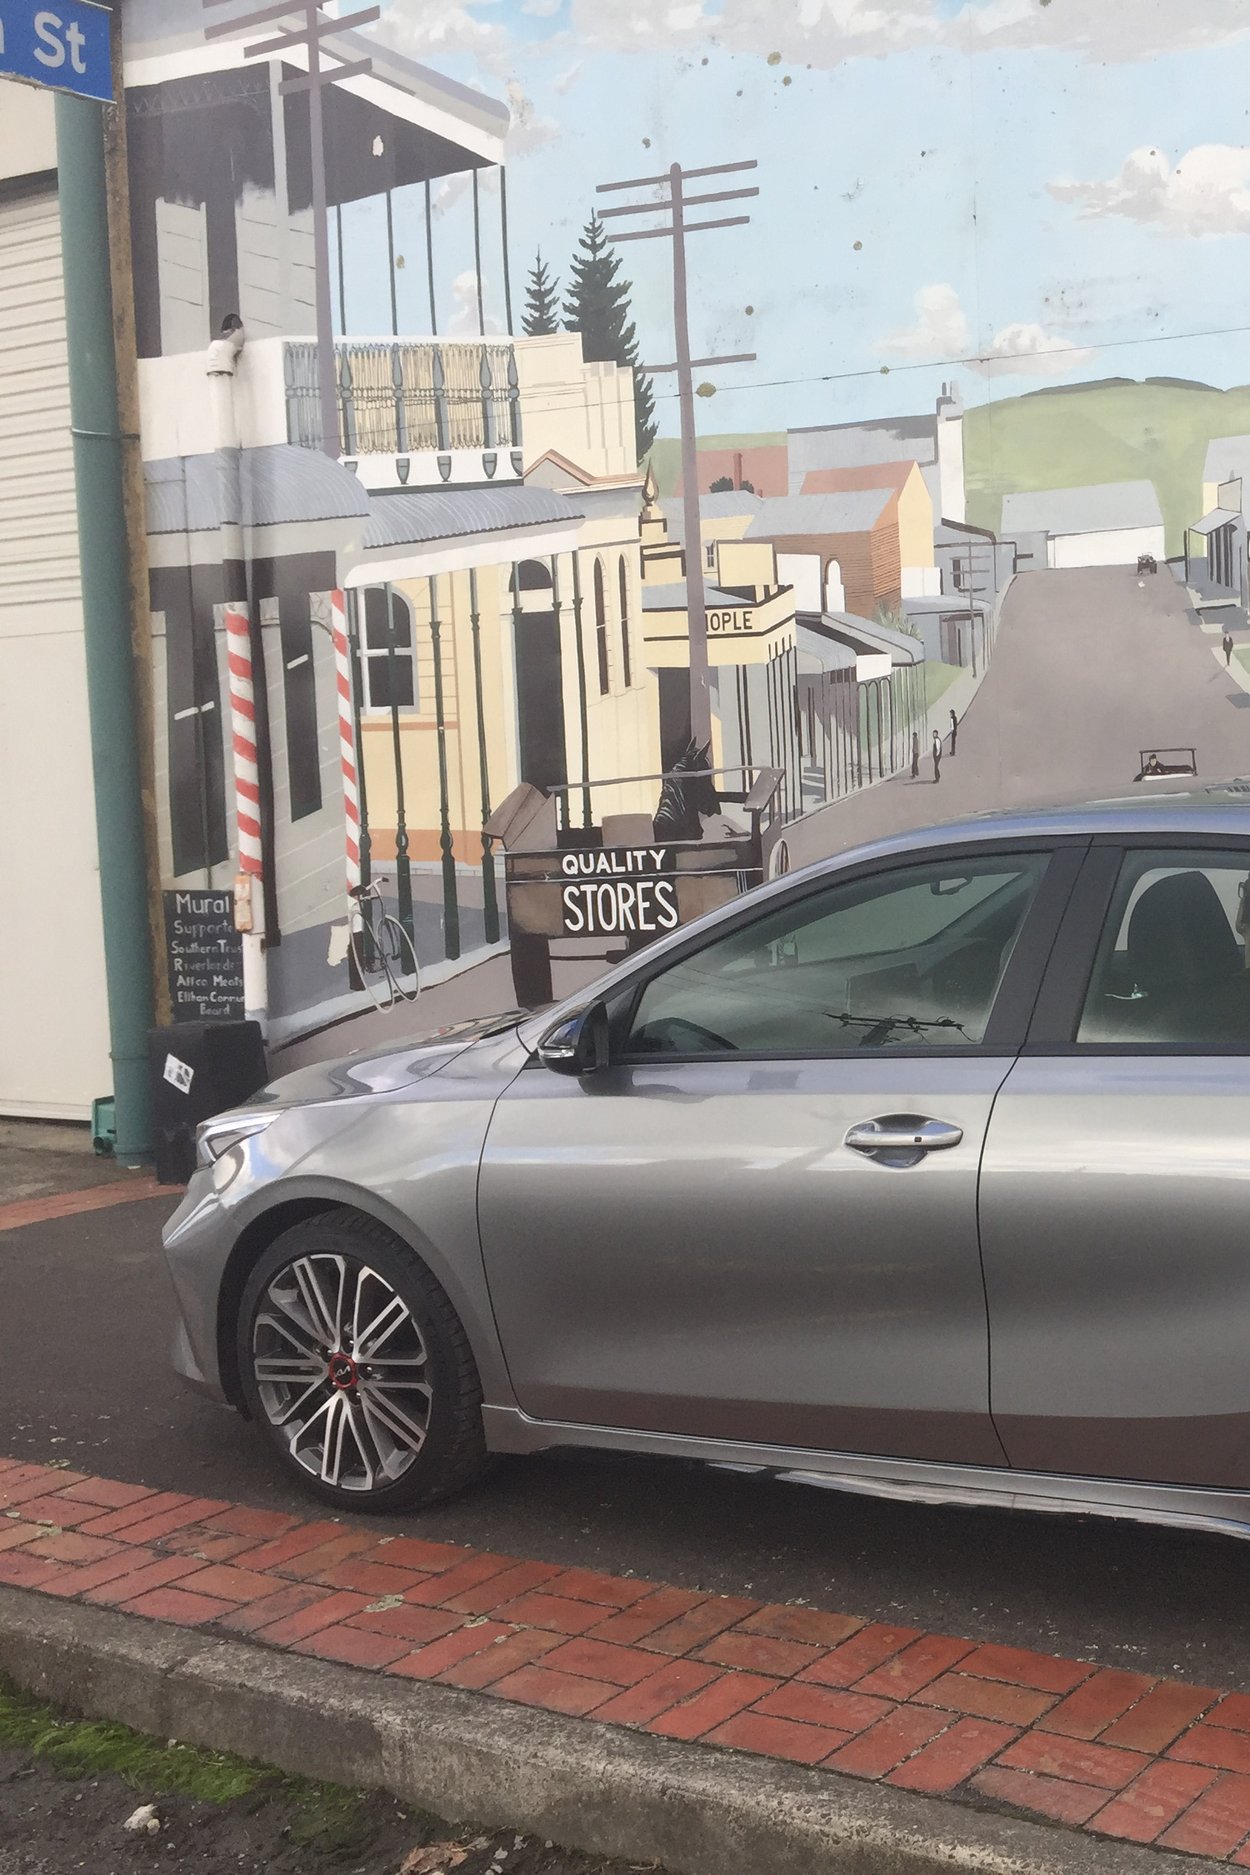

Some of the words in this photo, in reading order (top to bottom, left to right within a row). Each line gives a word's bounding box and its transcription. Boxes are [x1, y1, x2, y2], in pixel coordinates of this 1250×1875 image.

[33, 11, 87, 74] St
[562, 849, 666, 875] QUALITY
[175, 893, 230, 914] Mural
[563, 881, 678, 931] STORES
